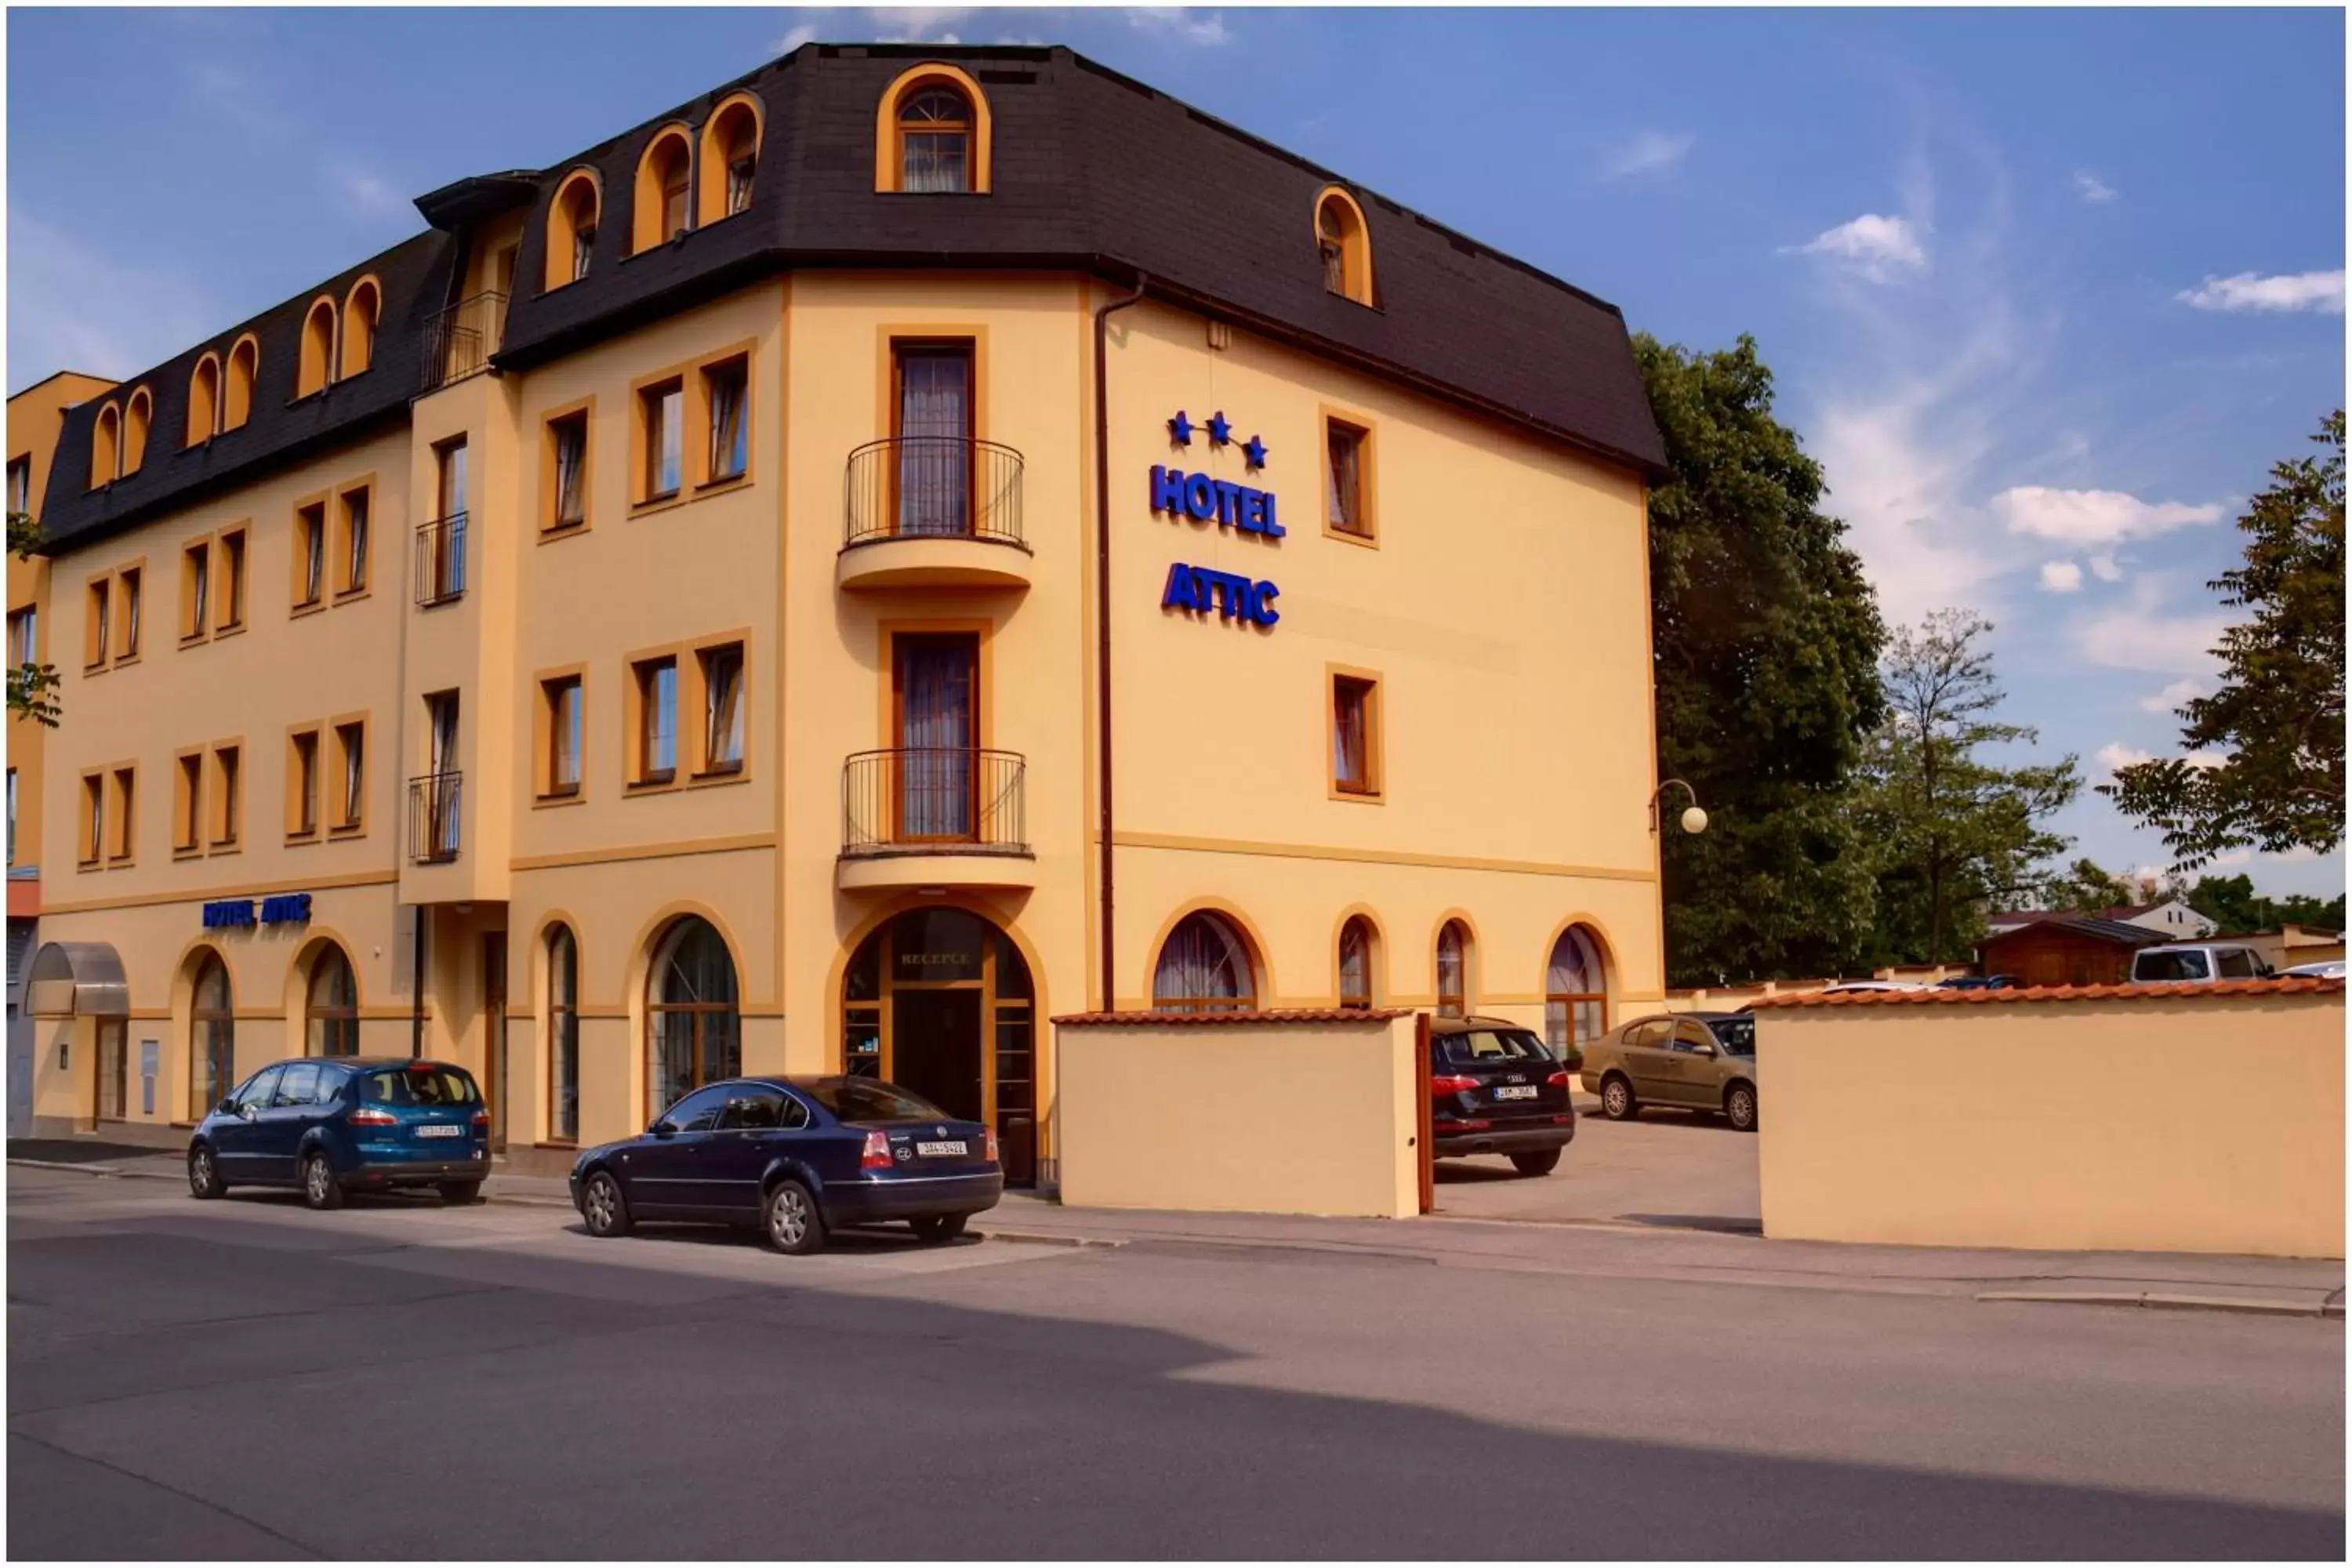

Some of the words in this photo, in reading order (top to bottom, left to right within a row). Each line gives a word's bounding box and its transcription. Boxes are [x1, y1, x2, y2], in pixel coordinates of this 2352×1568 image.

[1149, 465, 1286, 538] HOTEL
[1161, 562, 1279, 626] ATTIC
[203, 900, 256, 927] HOTEL
[261, 893, 311, 923] ATTIC
[902, 953, 971, 965] RECEPCE
